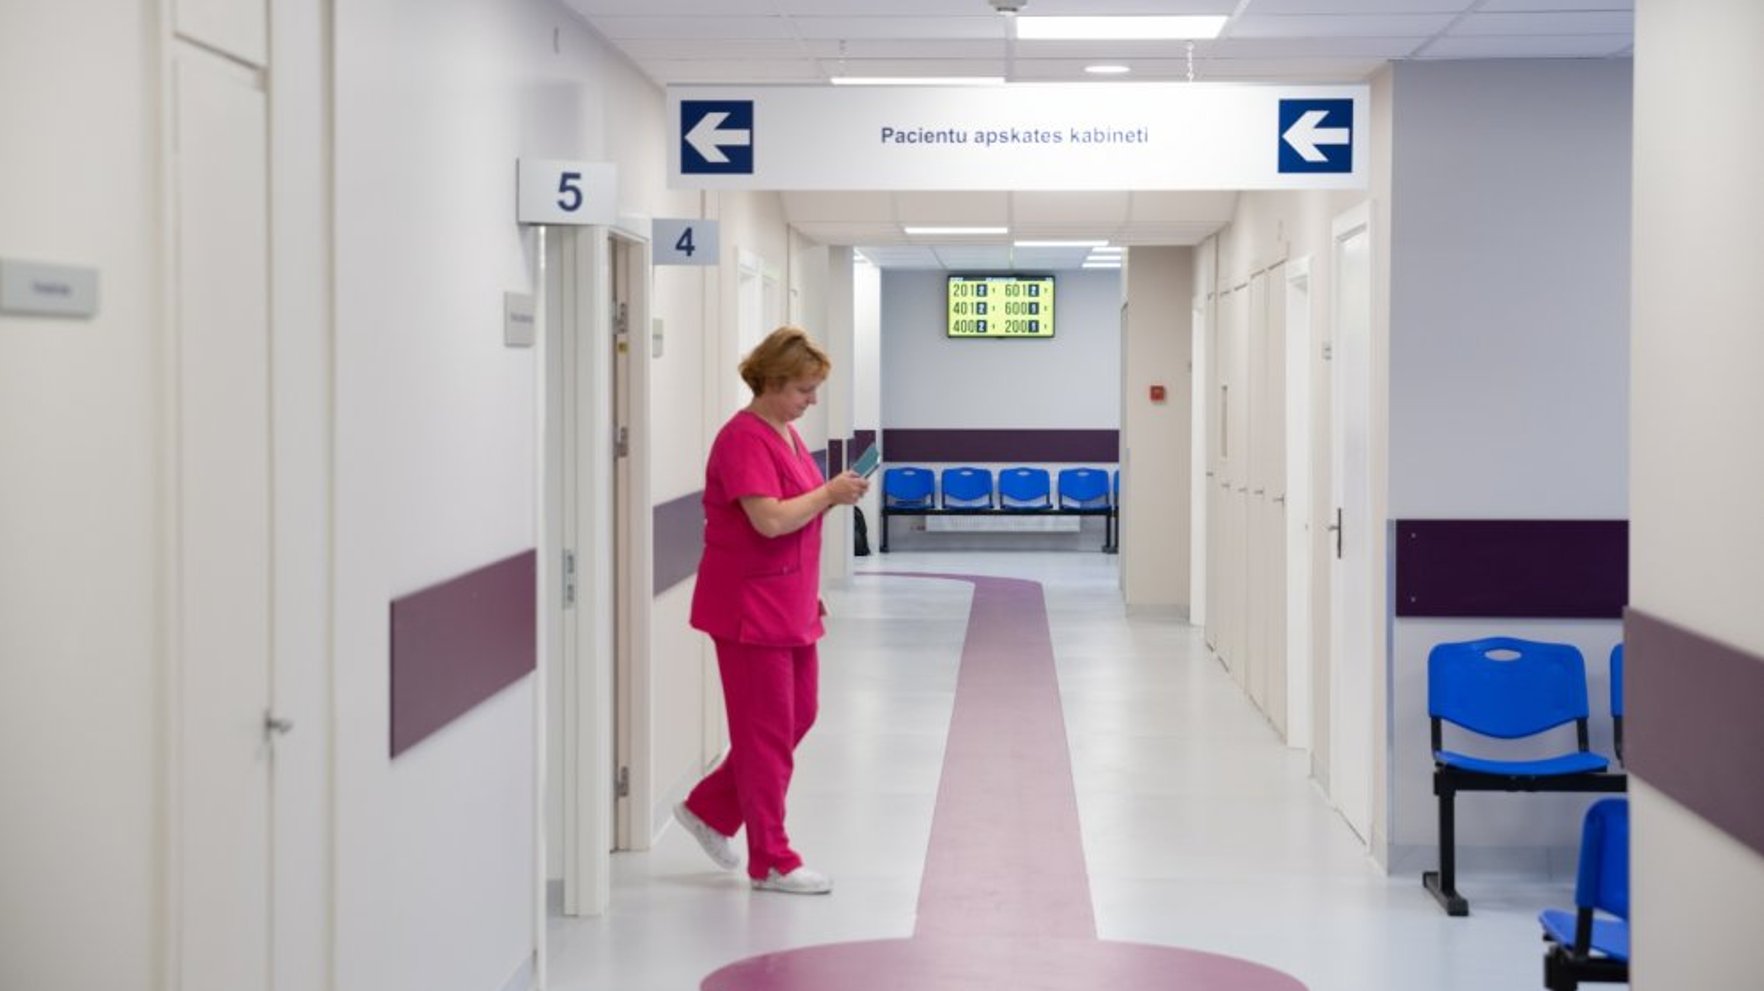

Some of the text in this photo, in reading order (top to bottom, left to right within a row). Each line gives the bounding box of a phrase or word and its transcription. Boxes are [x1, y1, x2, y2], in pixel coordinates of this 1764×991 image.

[881, 126, 1149, 147] Pacientu apskates kabineti
[557, 172, 583, 212] 5
[675, 227, 696, 257] 4
[953, 284, 974, 297] 201
[1005, 284, 1026, 297] 601
[953, 302, 974, 315] 401
[1005, 302, 1028, 315] 600
[953, 320, 976, 333] 400
[1005, 320, 1028, 333] 200
